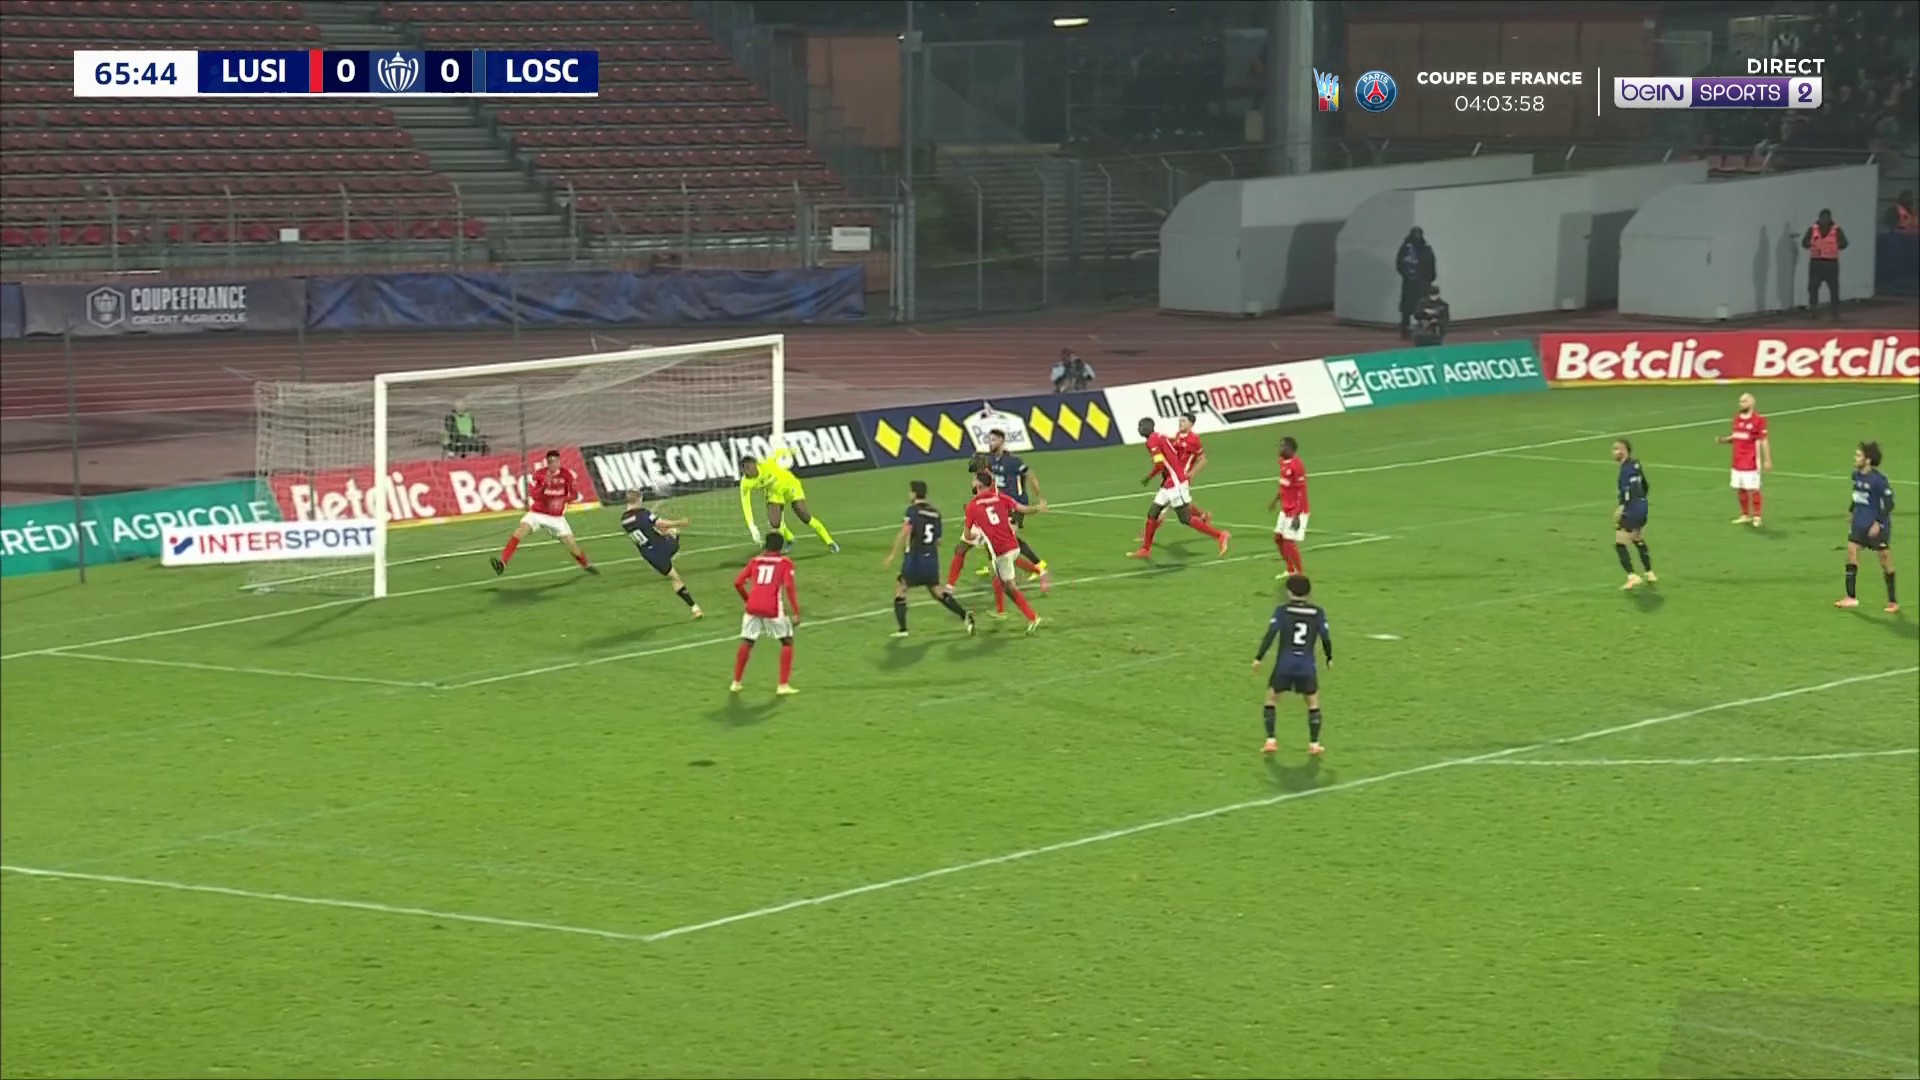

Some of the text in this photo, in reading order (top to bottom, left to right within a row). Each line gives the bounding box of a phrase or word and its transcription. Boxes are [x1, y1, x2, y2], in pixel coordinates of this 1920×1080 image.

[131, 287, 181, 311] COUPE
[189, 286, 248, 310] FRANCE
[131, 312, 248, 325] CRÉDIT AGRICOLE
[1555, 339, 1724, 380] Betclic
[1755, 336, 1918, 378] Betclic
[1364, 362, 1439, 392] CRÉDIT
[1442, 356, 1539, 384] AGRICOLE
[1151, 373, 1297, 420] Intermarché
[985, 505, 1000, 526] 6
[0, 520, 100, 557] RÉDIT
[199, 527, 376, 554] INTERSPORT
[923, 523, 935, 544] 5
[756, 565, 775, 585] 11
[1292, 622, 1308, 645] 2
